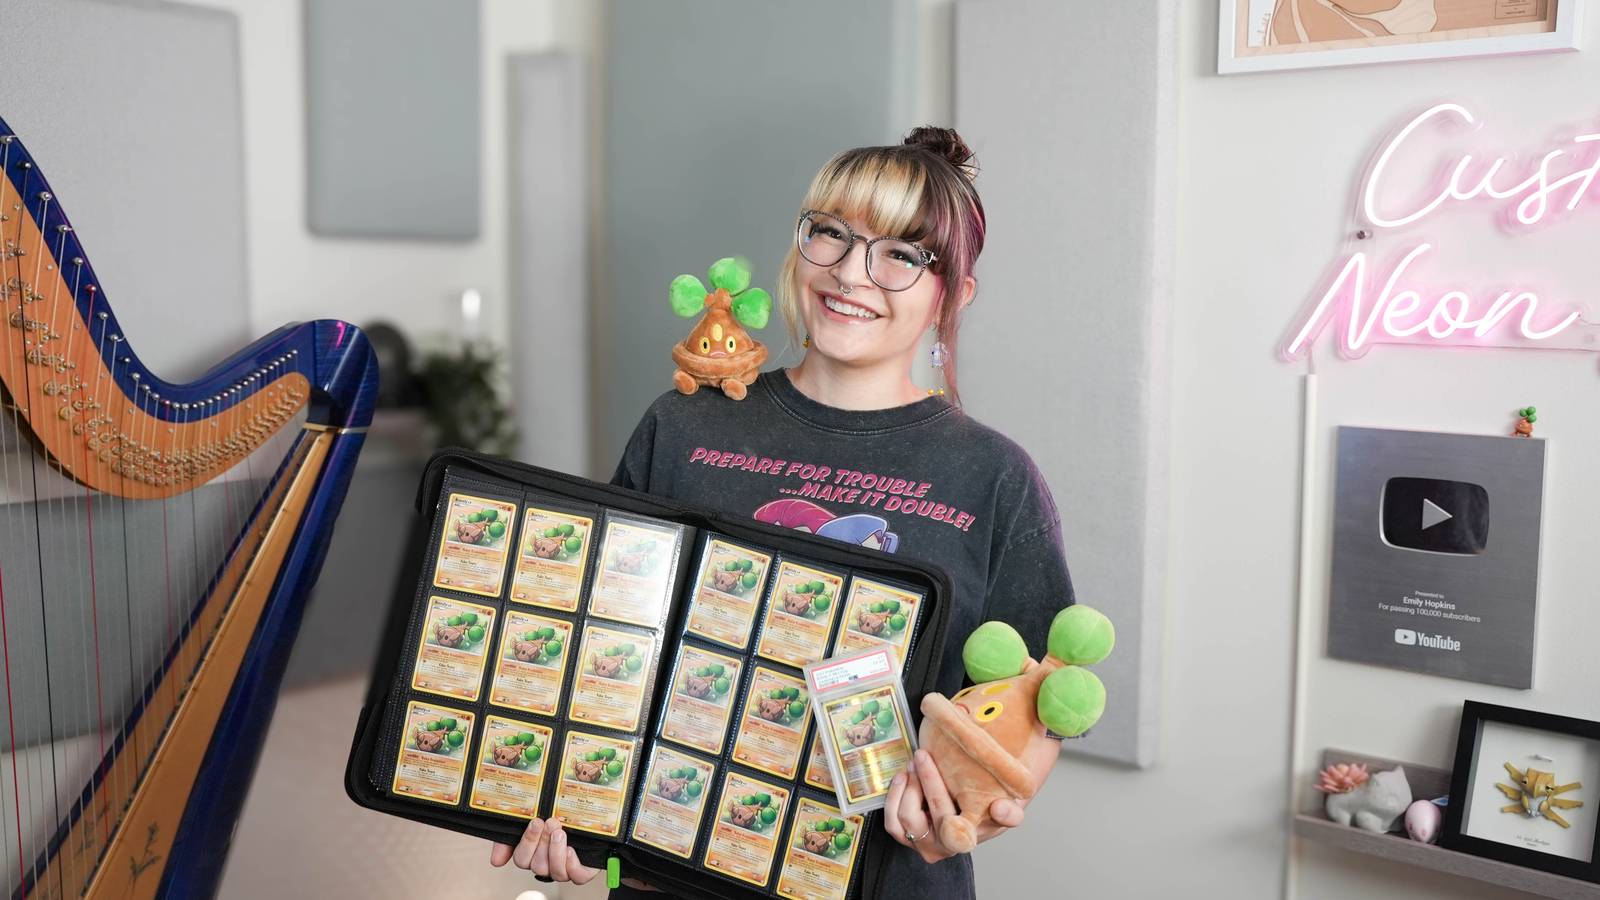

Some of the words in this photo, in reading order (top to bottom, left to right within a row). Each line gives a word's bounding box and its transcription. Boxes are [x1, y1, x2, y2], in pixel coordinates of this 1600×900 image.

[1288, 243, 1581, 352] Neon
[690, 447, 787, 476] PREPARE
[785, 461, 831, 482] FOR
[834, 468, 932, 499] TROUBLE
[860, 490, 884, 506] IT
[884, 499, 976, 532] DOUBLE!
[1389, 605, 1415, 615] passing
[1416, 608, 1441, 617] 100,000
[1442, 612, 1481, 622] subscribers
[1403, 597, 1423, 607] Emily
[1424, 600, 1456, 610] Hopkins
[1417, 632, 1460, 651] YouTube
